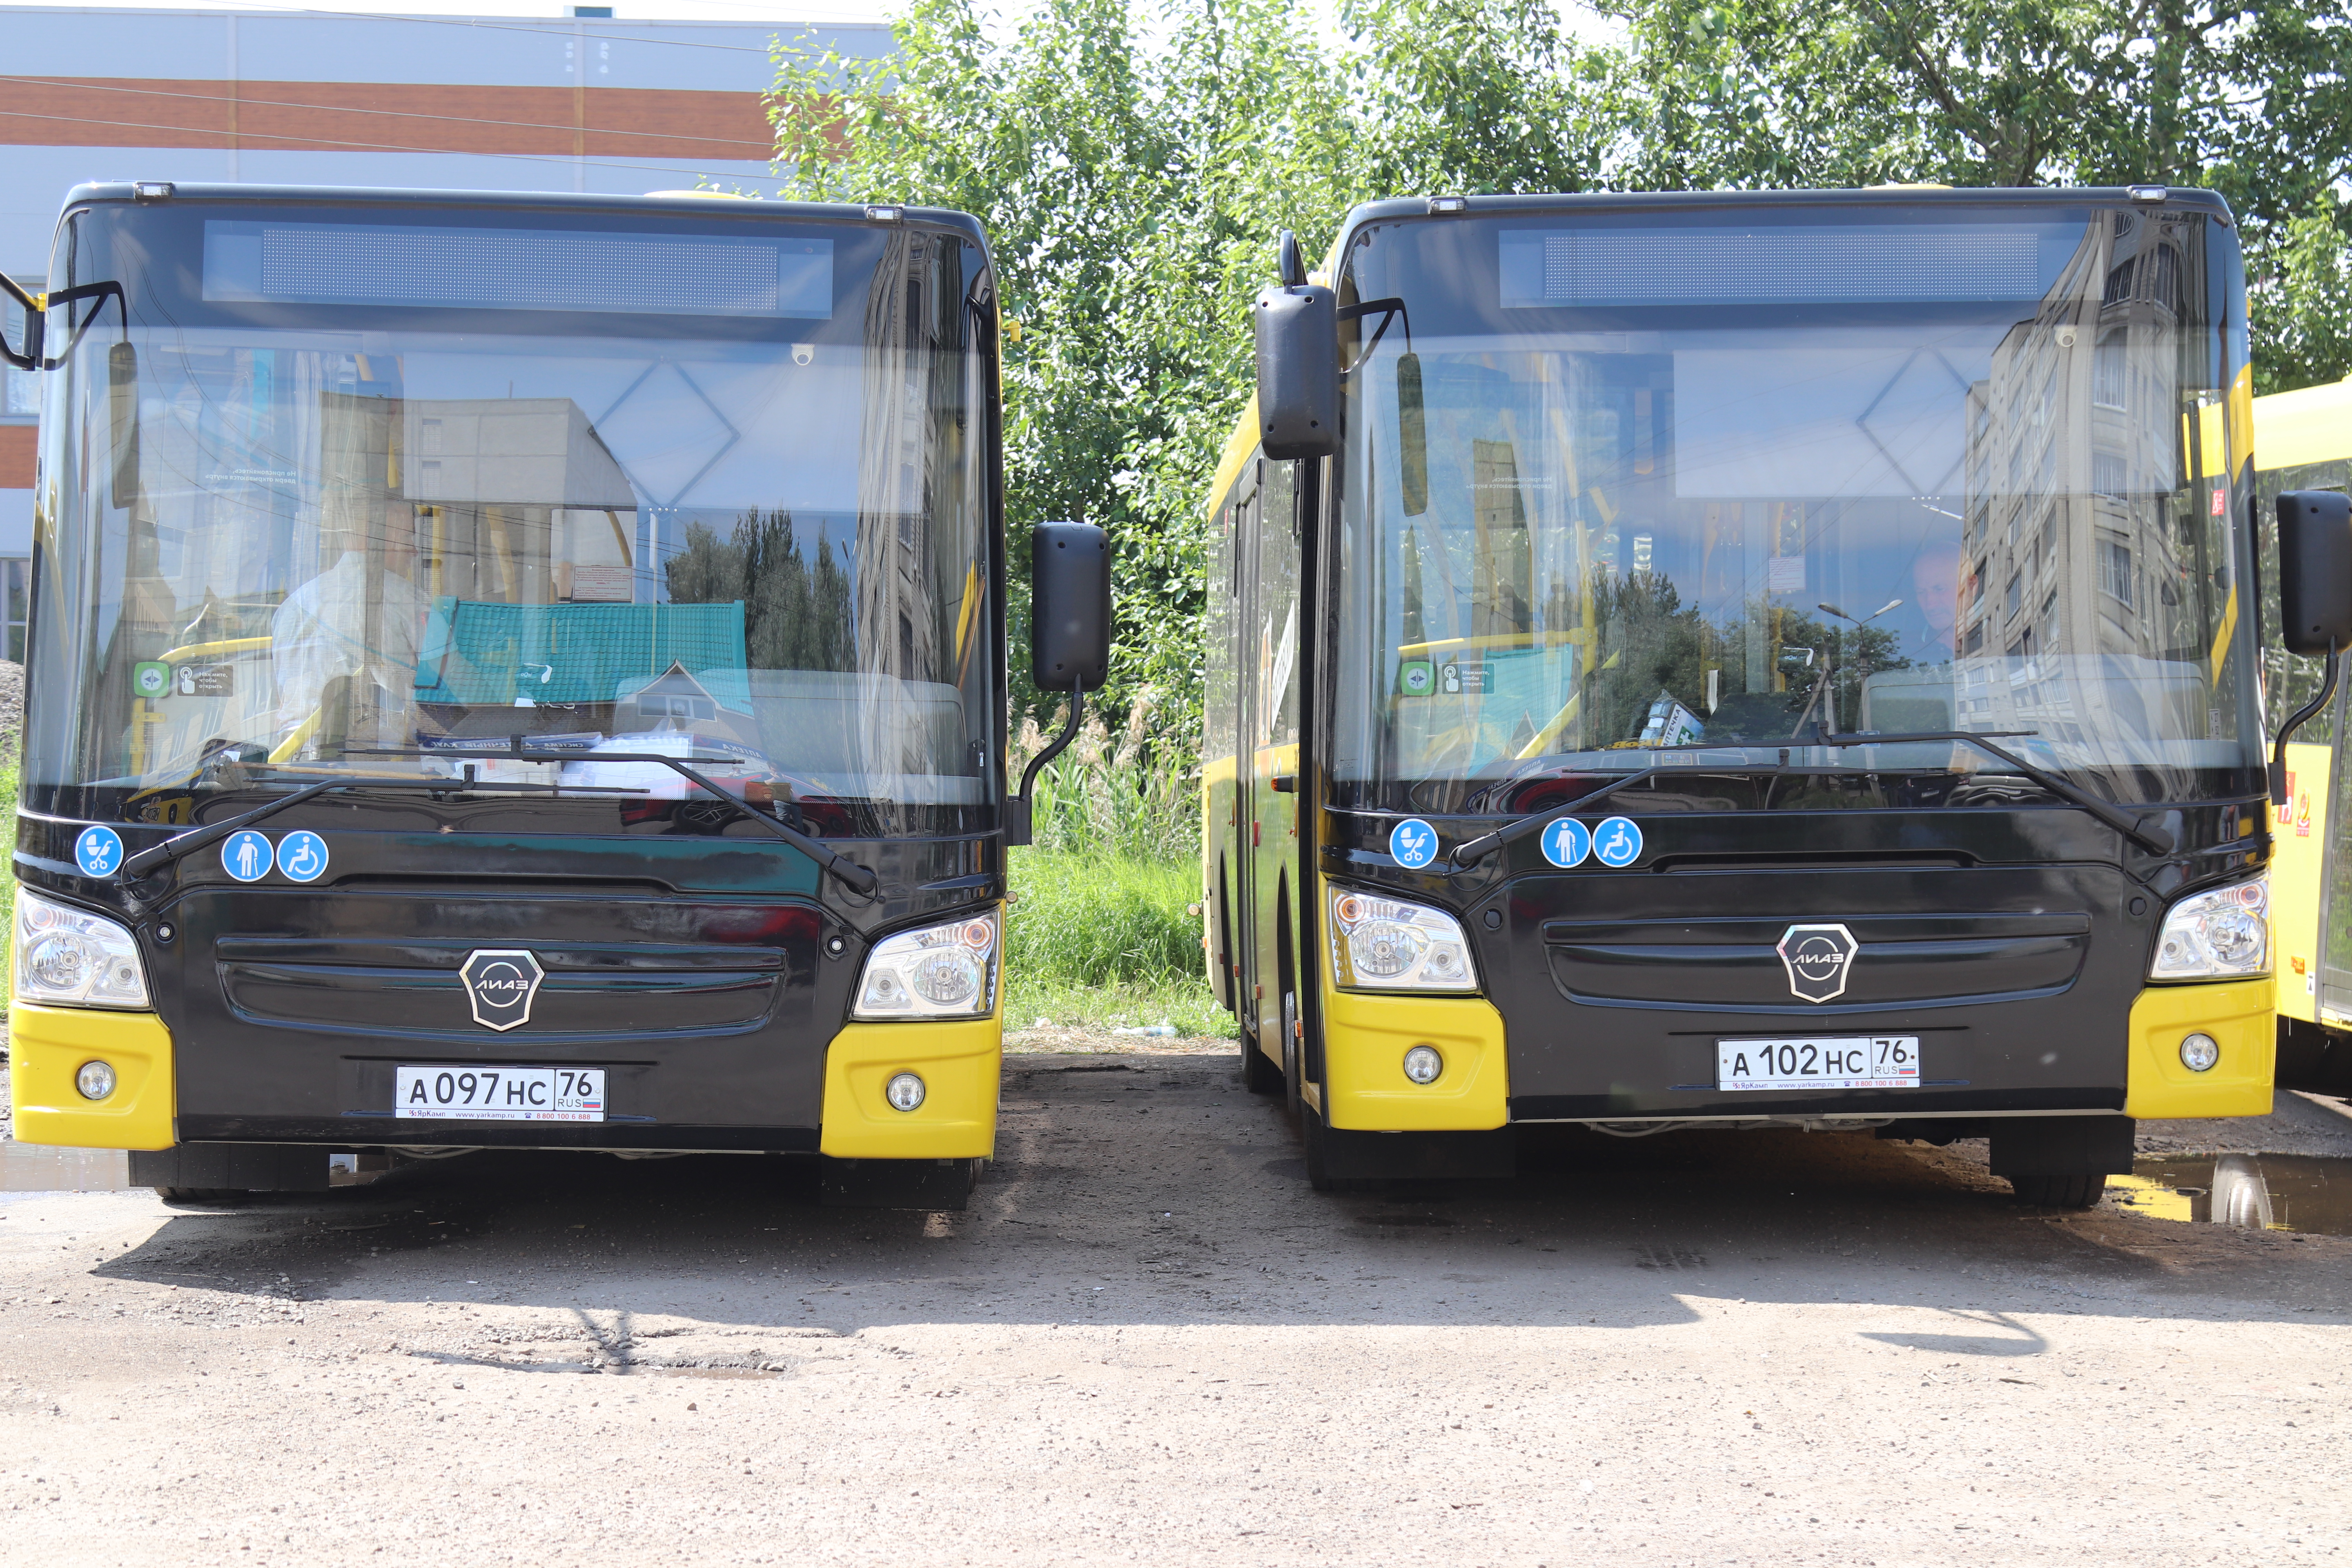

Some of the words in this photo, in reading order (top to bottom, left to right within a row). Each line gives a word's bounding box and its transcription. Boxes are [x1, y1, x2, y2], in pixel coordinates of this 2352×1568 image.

[1663, 709, 1681, 747] АПТЕЧКА
[1791, 953, 1844, 964] ЛИАЗ
[475, 980, 529, 990] ЛИАЗ
[1876, 1040, 1907, 1064] 76
[1875, 1066, 1897, 1074] RUS
[560, 1073, 592, 1096] 76
[558, 1099, 581, 1107] RUS
[417, 1110, 446, 1118] ЯрКамп
